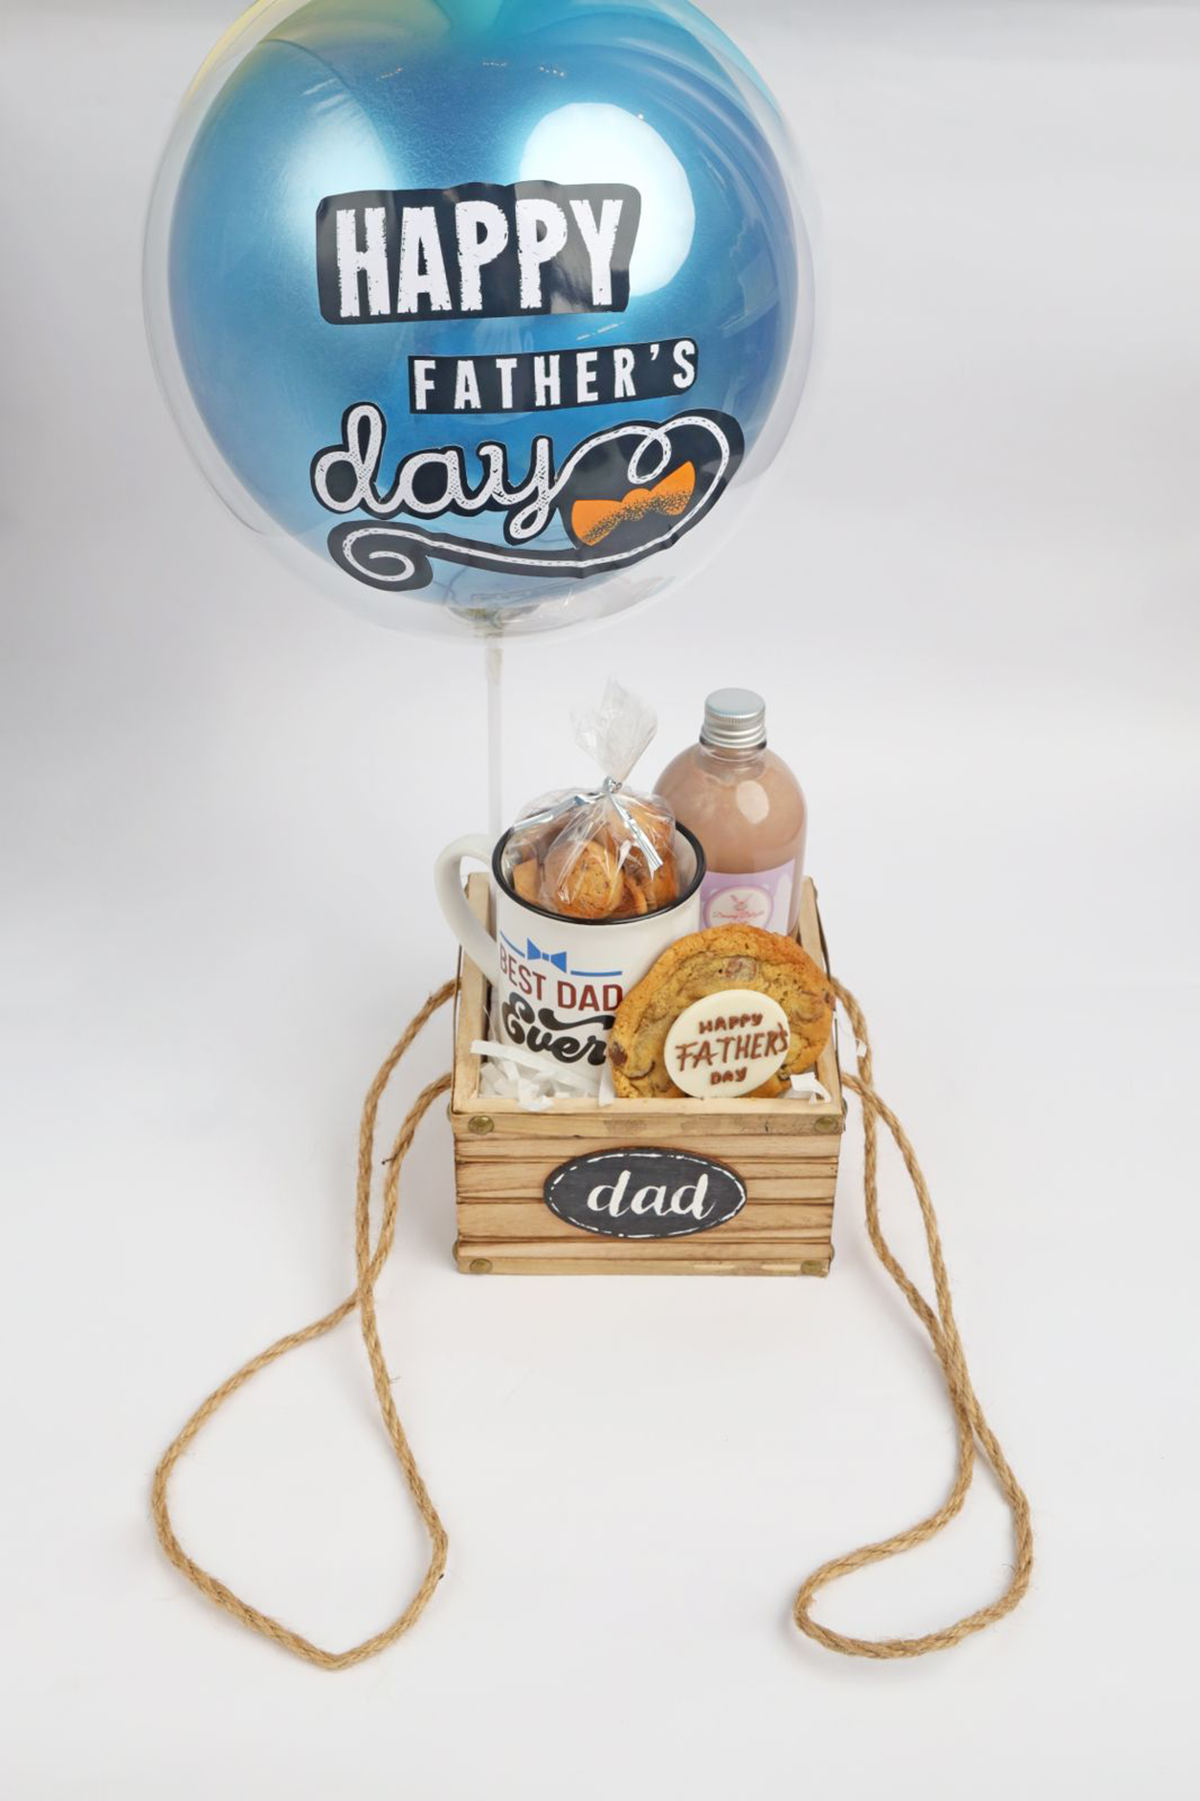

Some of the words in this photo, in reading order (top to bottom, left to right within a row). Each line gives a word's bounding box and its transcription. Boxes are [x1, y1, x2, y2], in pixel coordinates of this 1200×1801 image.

[335, 198, 624, 318] HAPPY
[412, 340, 696, 411] FATHER'S
[313, 404, 558, 541] day
[500, 942, 547, 1001] BEST
[557, 980, 623, 1012] DAD
[501, 991, 607, 1066] Ever
[698, 1013, 763, 1034] HAPPY
[710, 1067, 748, 1085] DAY
[587, 1169, 716, 1220] dad
